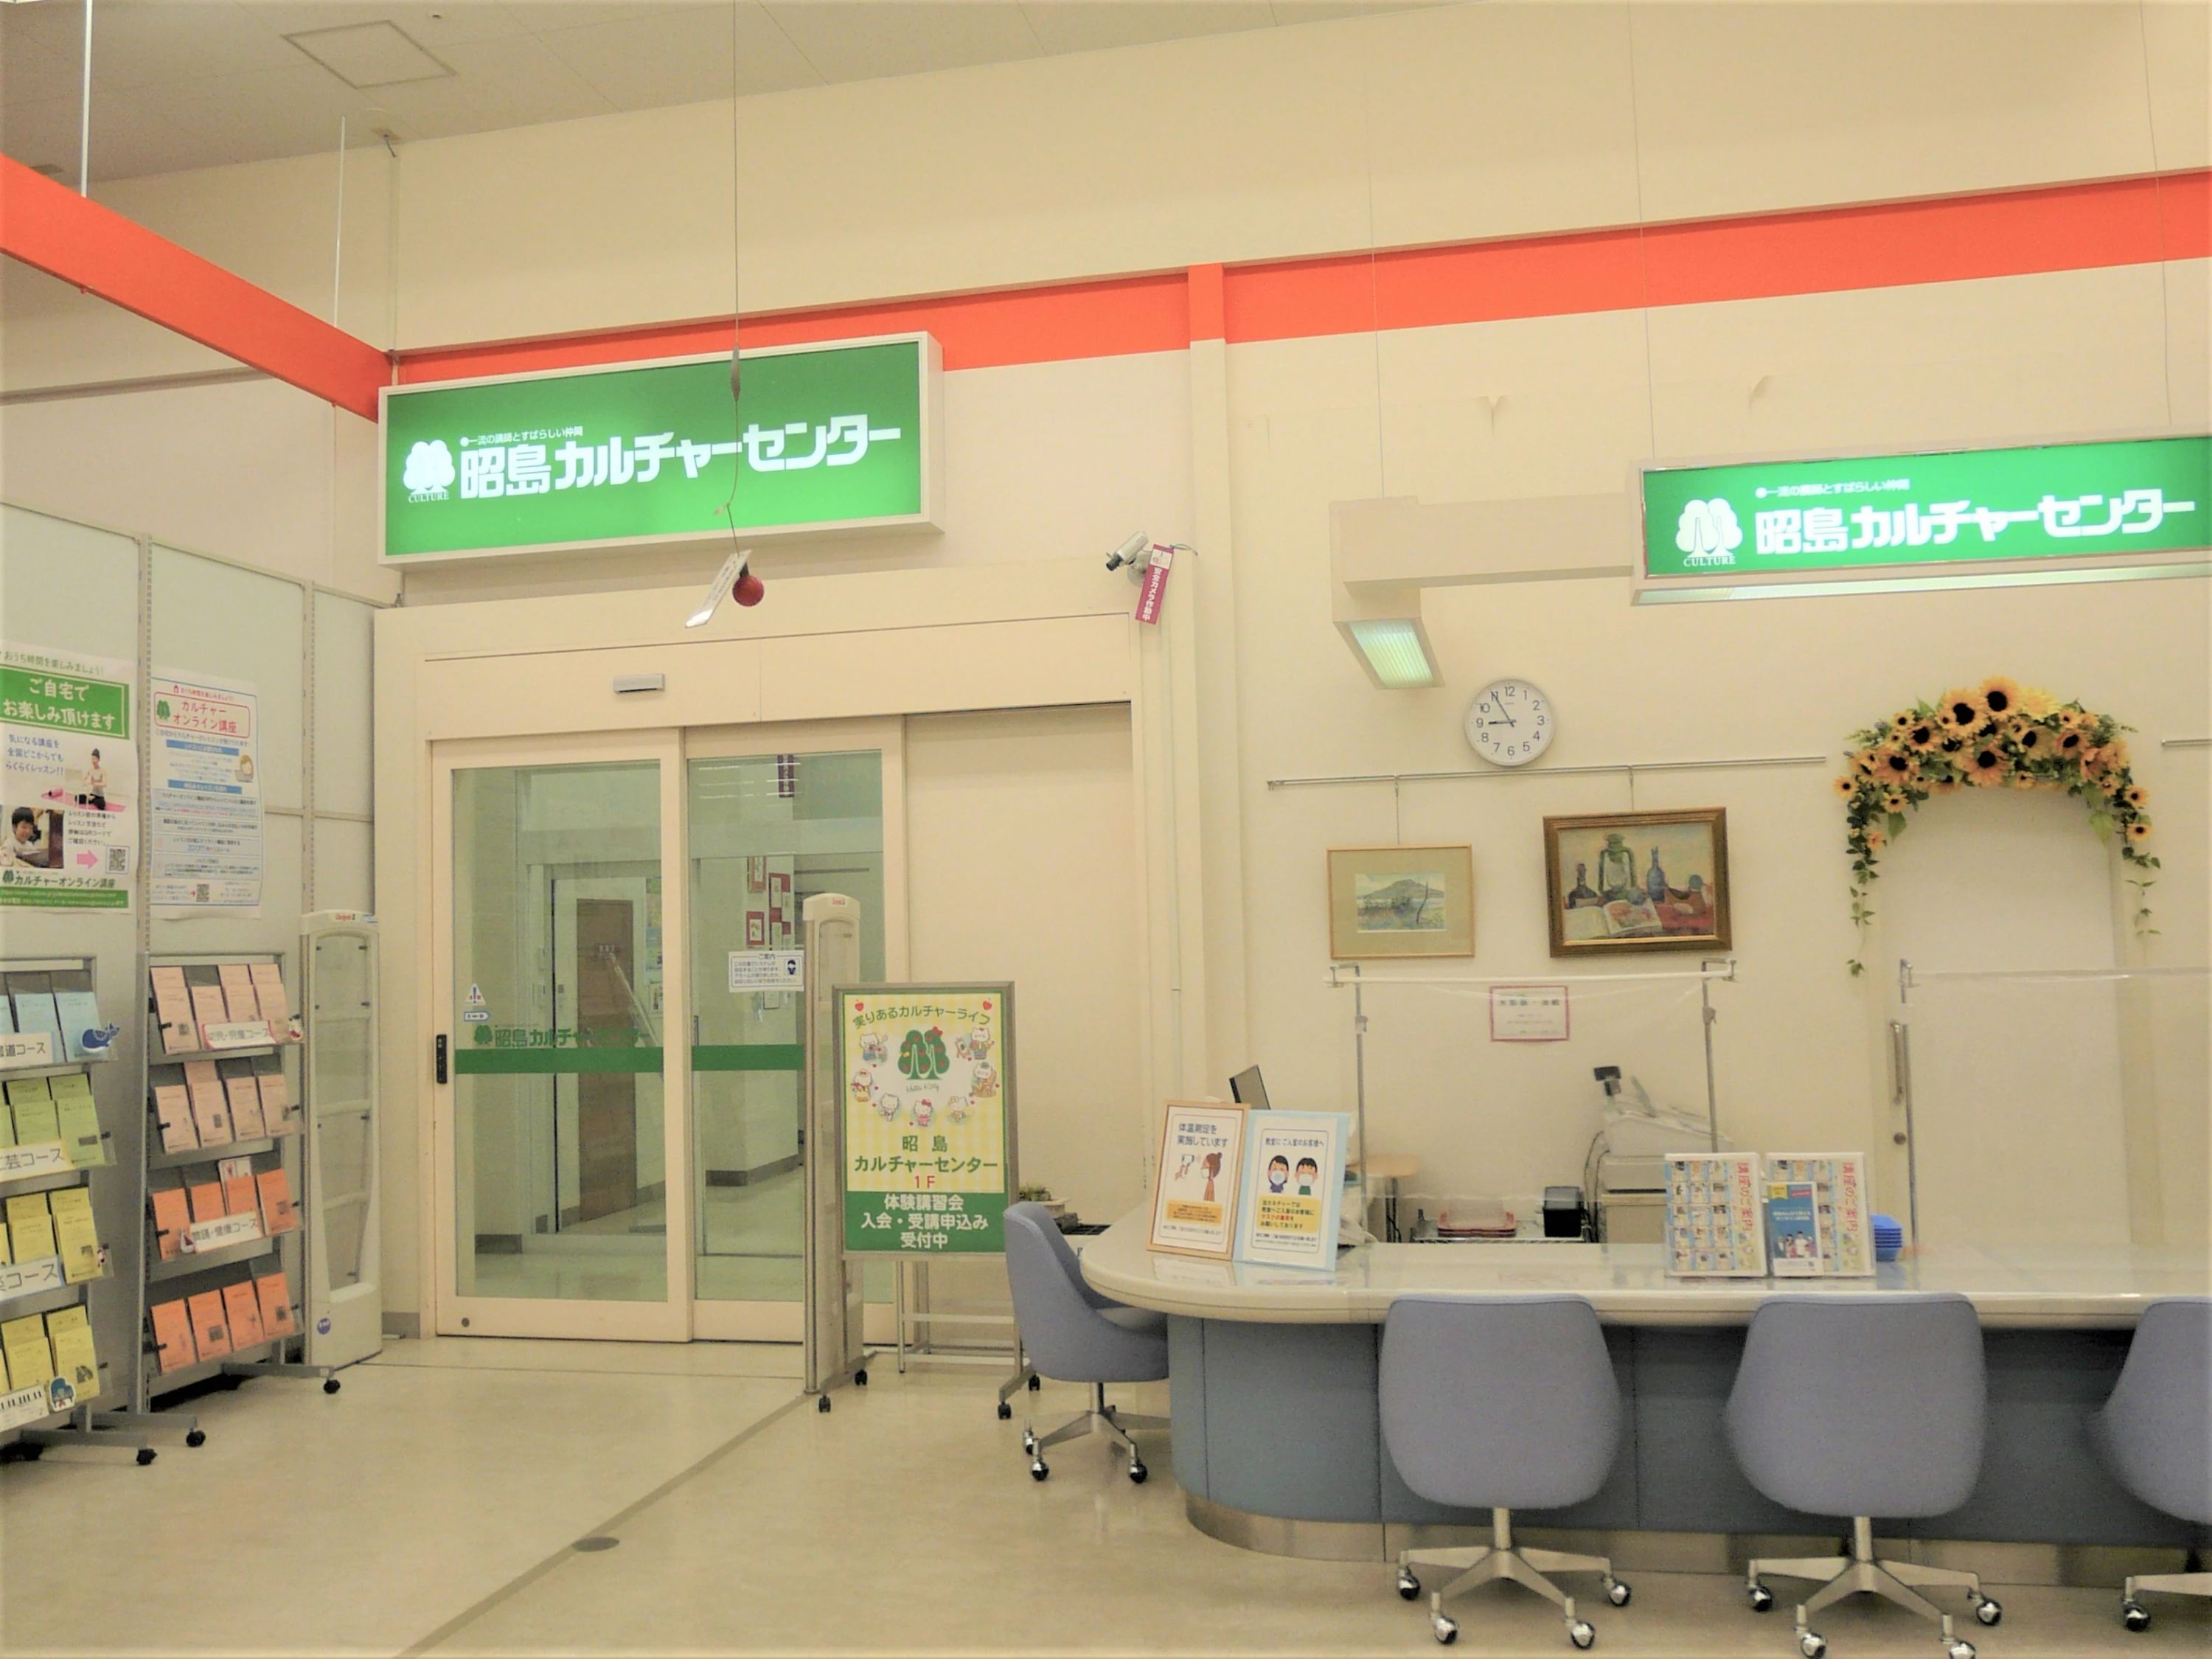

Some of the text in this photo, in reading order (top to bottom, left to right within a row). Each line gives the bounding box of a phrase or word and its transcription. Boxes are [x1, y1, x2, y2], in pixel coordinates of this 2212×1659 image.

[408, 490, 450, 504] CULTURE
[1683, 554, 1736, 566] CULTURE
[29, 677, 89, 702] ご自宅で
[1504, 686, 1515, 697] 12
[181, 700, 227, 715] カルチャー
[1480, 703, 1490, 713] 10
[1533, 700, 1540, 711] 2
[3, 698, 115, 730] お楽しみ頂けます
[1537, 715, 1545, 726] 3
[173, 713, 237, 734] オンライン講座
[1475, 717, 1484, 728] 9
[9, 734, 60, 748] 気になる講座を
[1481, 732, 1489, 742] 8
[1532, 731, 1540, 740] 4
[1493, 742, 1500, 753] 7
[1507, 745, 1515, 756] 6
[1523, 742, 1530, 751] 5
[7, 748, 64, 762] 全国どこからでも
[15, 874, 116, 888] カルチャーオンライン講座
[852, 1004, 991, 1029] 実りあるカルチャーライフ
[1178, 1122, 1217, 1134] 体温測定を
[1177, 1135, 1228, 1148] 実施しています
[855, 1155, 998, 1175] カルチャーセンター
[884, 1194, 964, 1212] 体験講習会
[860, 1212, 989, 1230] 入会・受講申込み
[900, 1231, 949, 1250] 受付中
